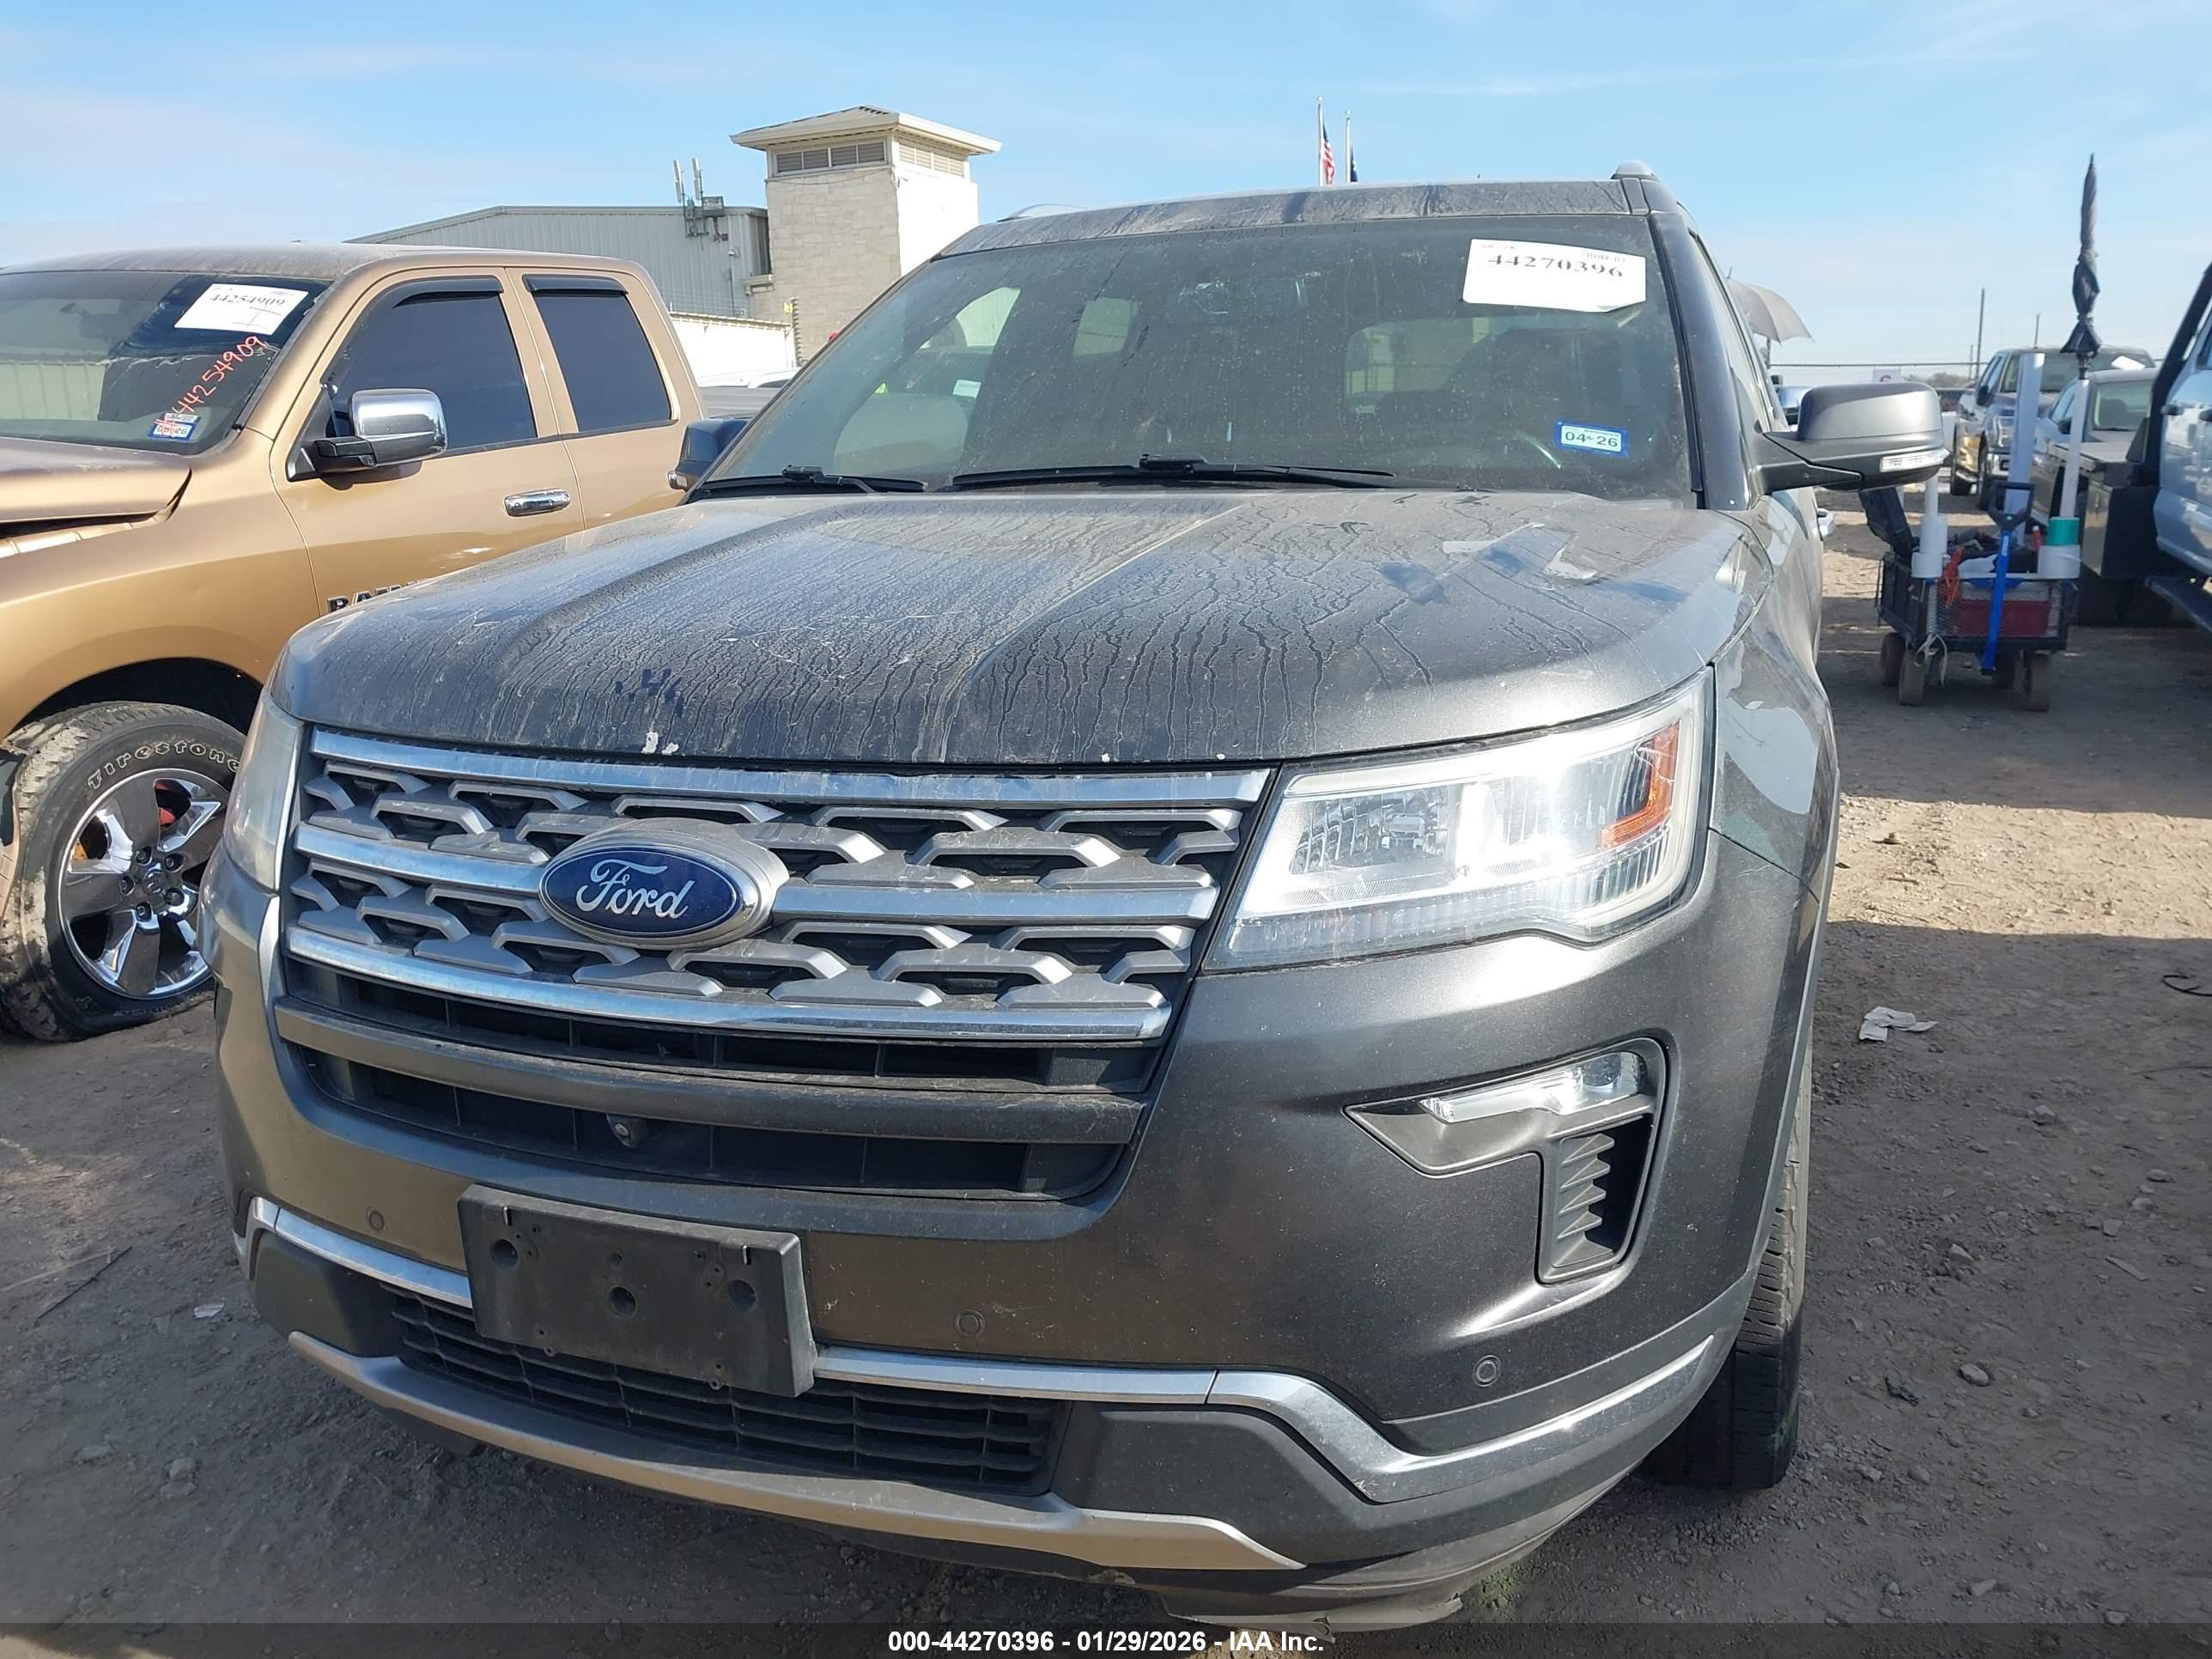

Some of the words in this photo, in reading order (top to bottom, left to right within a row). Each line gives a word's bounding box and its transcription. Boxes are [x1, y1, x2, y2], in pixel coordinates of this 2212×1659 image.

[1488, 254, 1624, 277] 44270396
[209, 293, 286, 307] 44254909
[88, 740, 241, 790] Firestone
[575, 858, 695, 920] Ford
